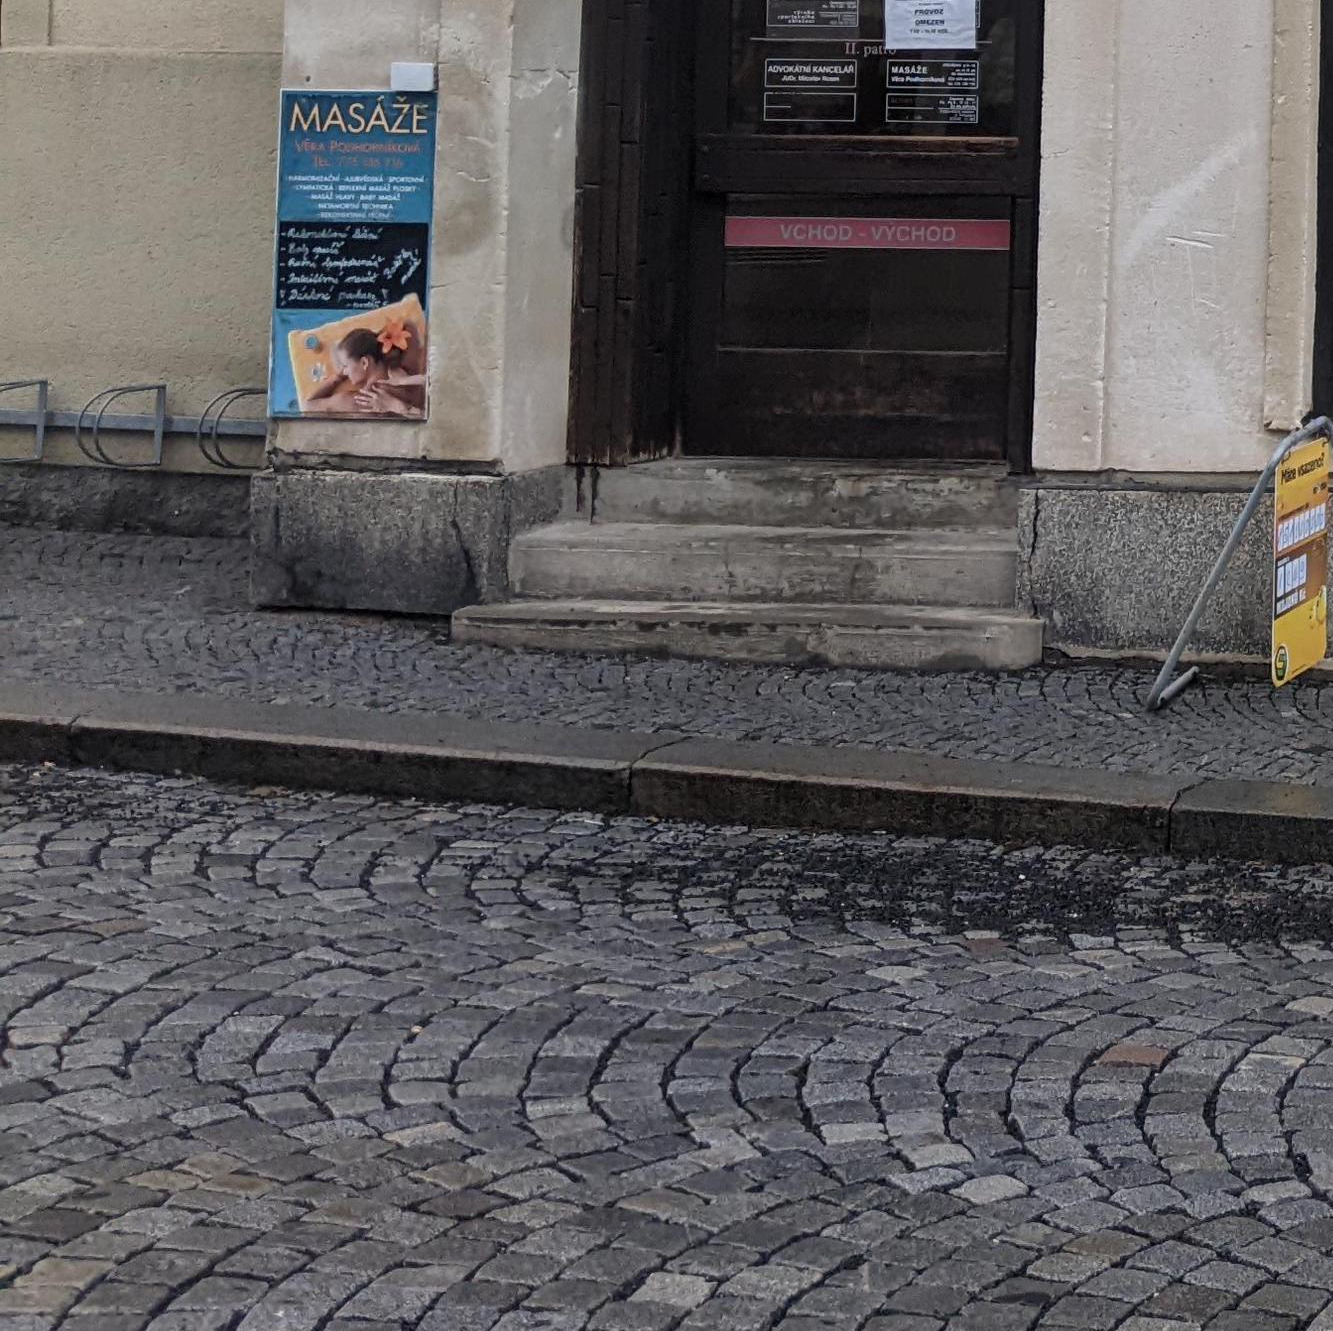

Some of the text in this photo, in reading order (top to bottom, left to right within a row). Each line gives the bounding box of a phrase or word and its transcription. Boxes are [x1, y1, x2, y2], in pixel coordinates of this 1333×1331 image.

[891, 64, 929, 75] MASÁŽE
[289, 95, 429, 133] MASÁŽE
[780, 224, 853, 241] VCHOD
[871, 222, 957, 243] VÝCHOD
